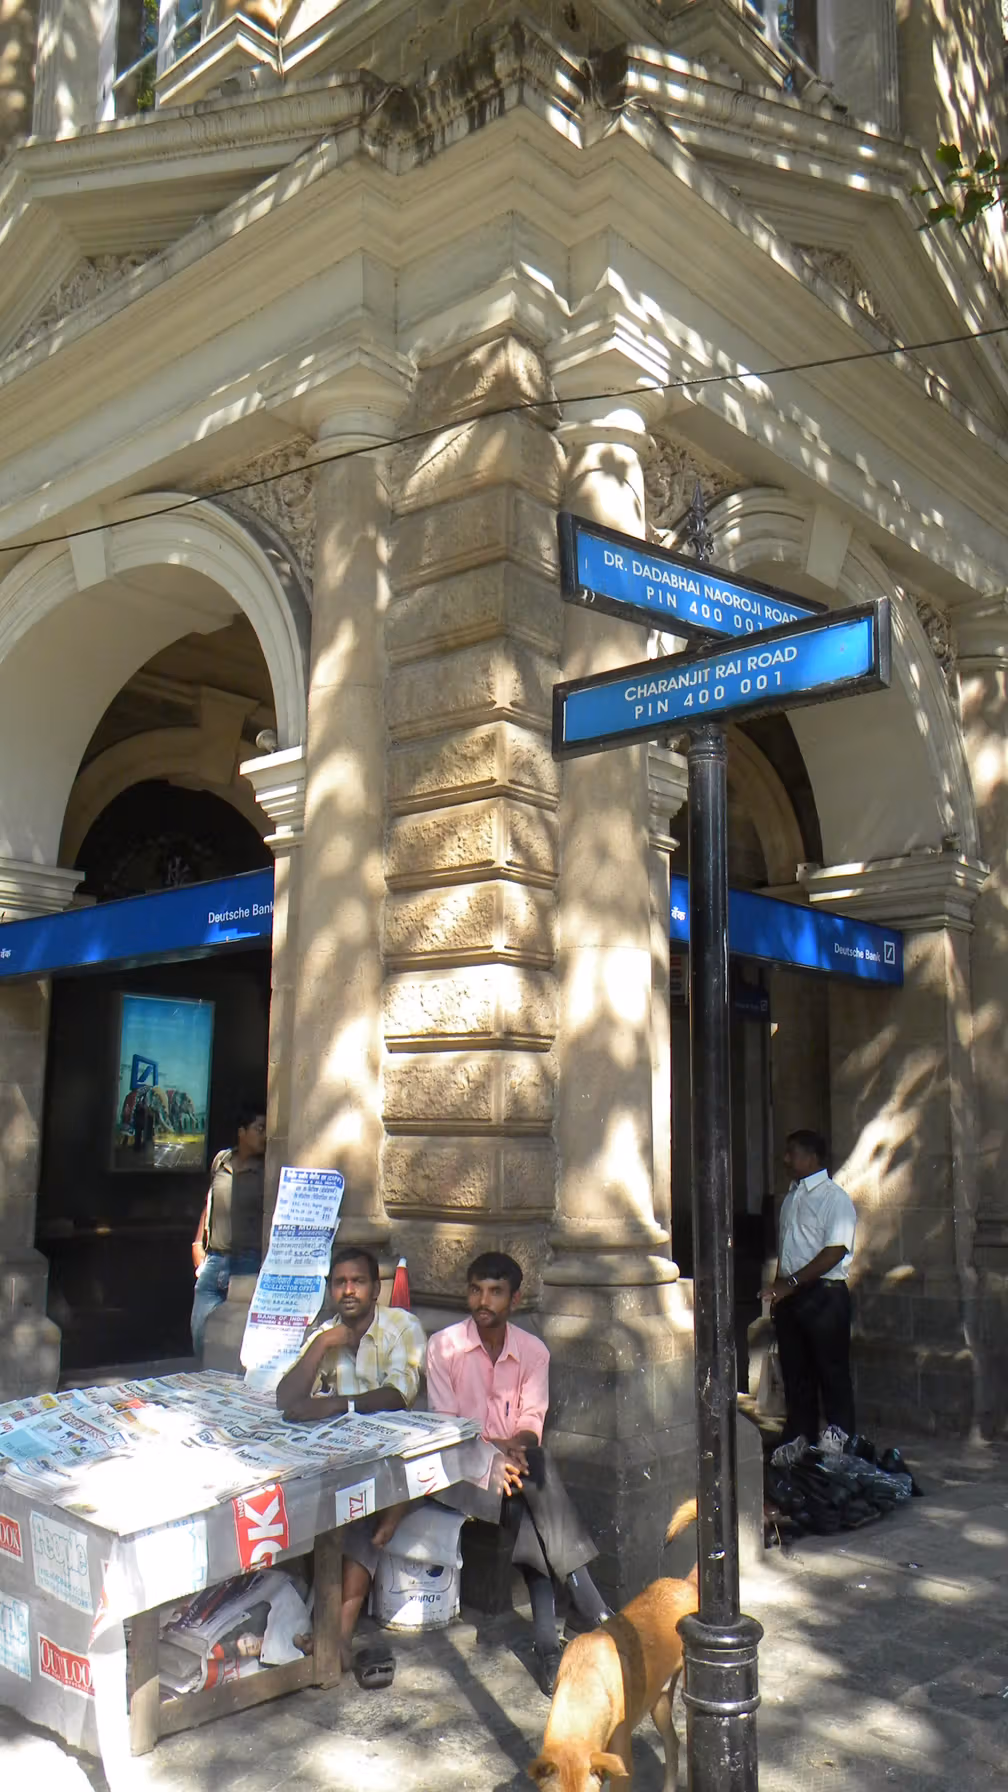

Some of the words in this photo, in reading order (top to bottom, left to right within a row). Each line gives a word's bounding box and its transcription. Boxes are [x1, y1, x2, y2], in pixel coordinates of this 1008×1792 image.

[603, 551, 628, 572] DR.
[632, 561, 700, 595] DADABHAI
[704, 586, 761, 616] NAOROJI
[765, 605, 798, 624] ROAD
[646, 586, 677, 608] PIN
[689, 601, 722, 623] 400
[624, 668, 711, 702] CHARANJIT
[715, 659, 742, 680] RAI
[747, 646, 798, 672] ROAD
[634, 699, 669, 720] PIN
[683, 684, 725, 708] 400
[740, 670, 782, 694] 001
[208, 906, 250, 924] Deutsche
[252, 901, 274, 916] Bank
[834, 942, 864, 959] Deutsche
[865, 949, 881, 962] Bank
[408, 1594, 435, 1603] Dulux
